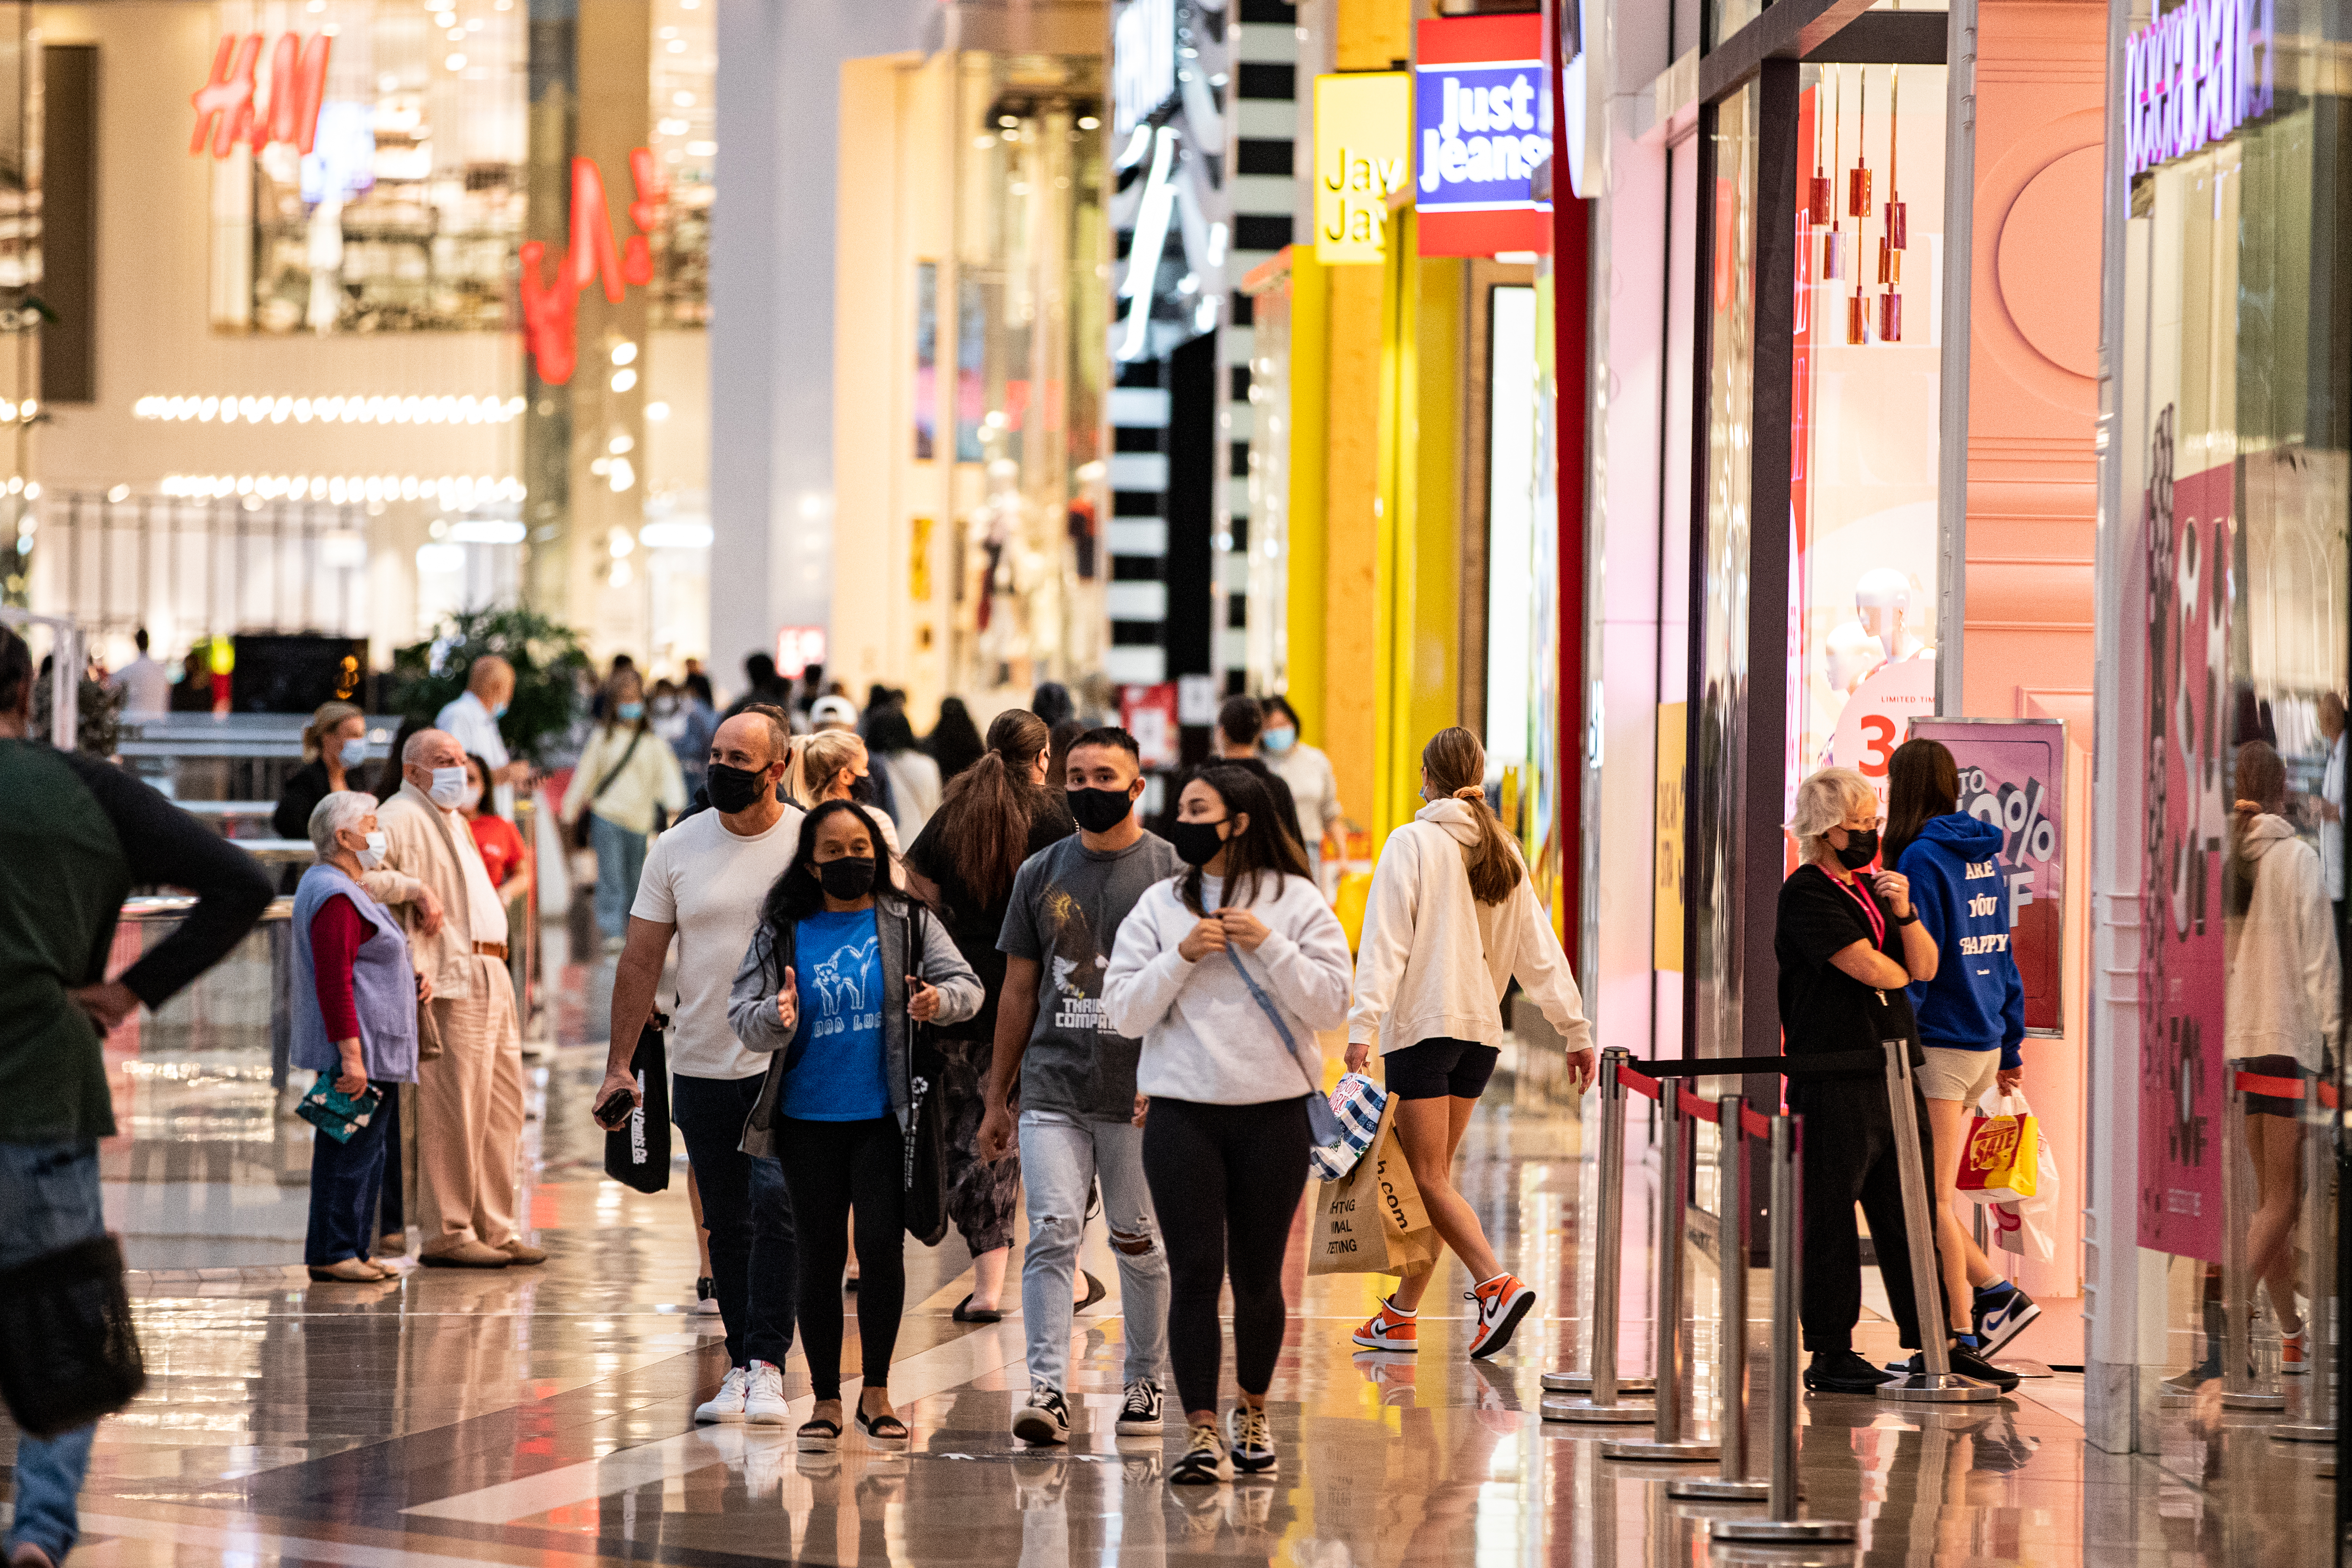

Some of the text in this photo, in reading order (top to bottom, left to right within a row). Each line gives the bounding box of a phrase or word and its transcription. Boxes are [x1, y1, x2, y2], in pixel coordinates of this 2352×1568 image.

[1440, 74, 1534, 139] Just
[1325, 147, 1403, 194] Jay
[1419, 128, 1552, 192] Jeans
[1859, 714, 1909, 777] 3
[1965, 862, 1995, 880] ARE
[1968, 893, 1998, 917] YOU
[814, 1016, 845, 1038] OOD
[1973, 1131, 2014, 1168] SALE
